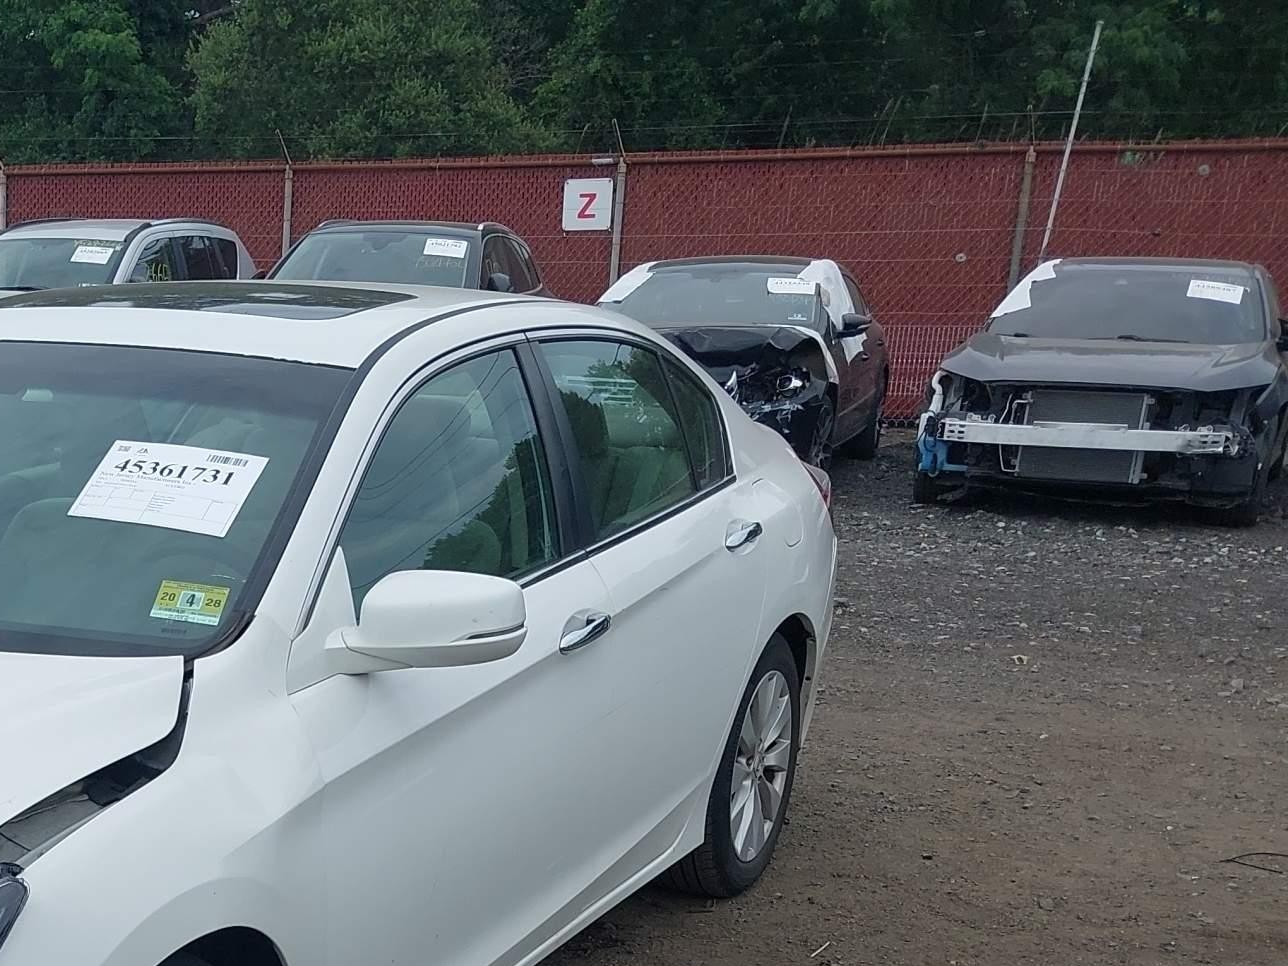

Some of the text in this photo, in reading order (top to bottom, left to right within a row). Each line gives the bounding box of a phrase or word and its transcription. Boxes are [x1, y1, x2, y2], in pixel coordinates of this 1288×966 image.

[577, 193, 597, 219] Z
[114, 457, 235, 486] 45361731
[160, 591, 222, 608] 20 4 28
